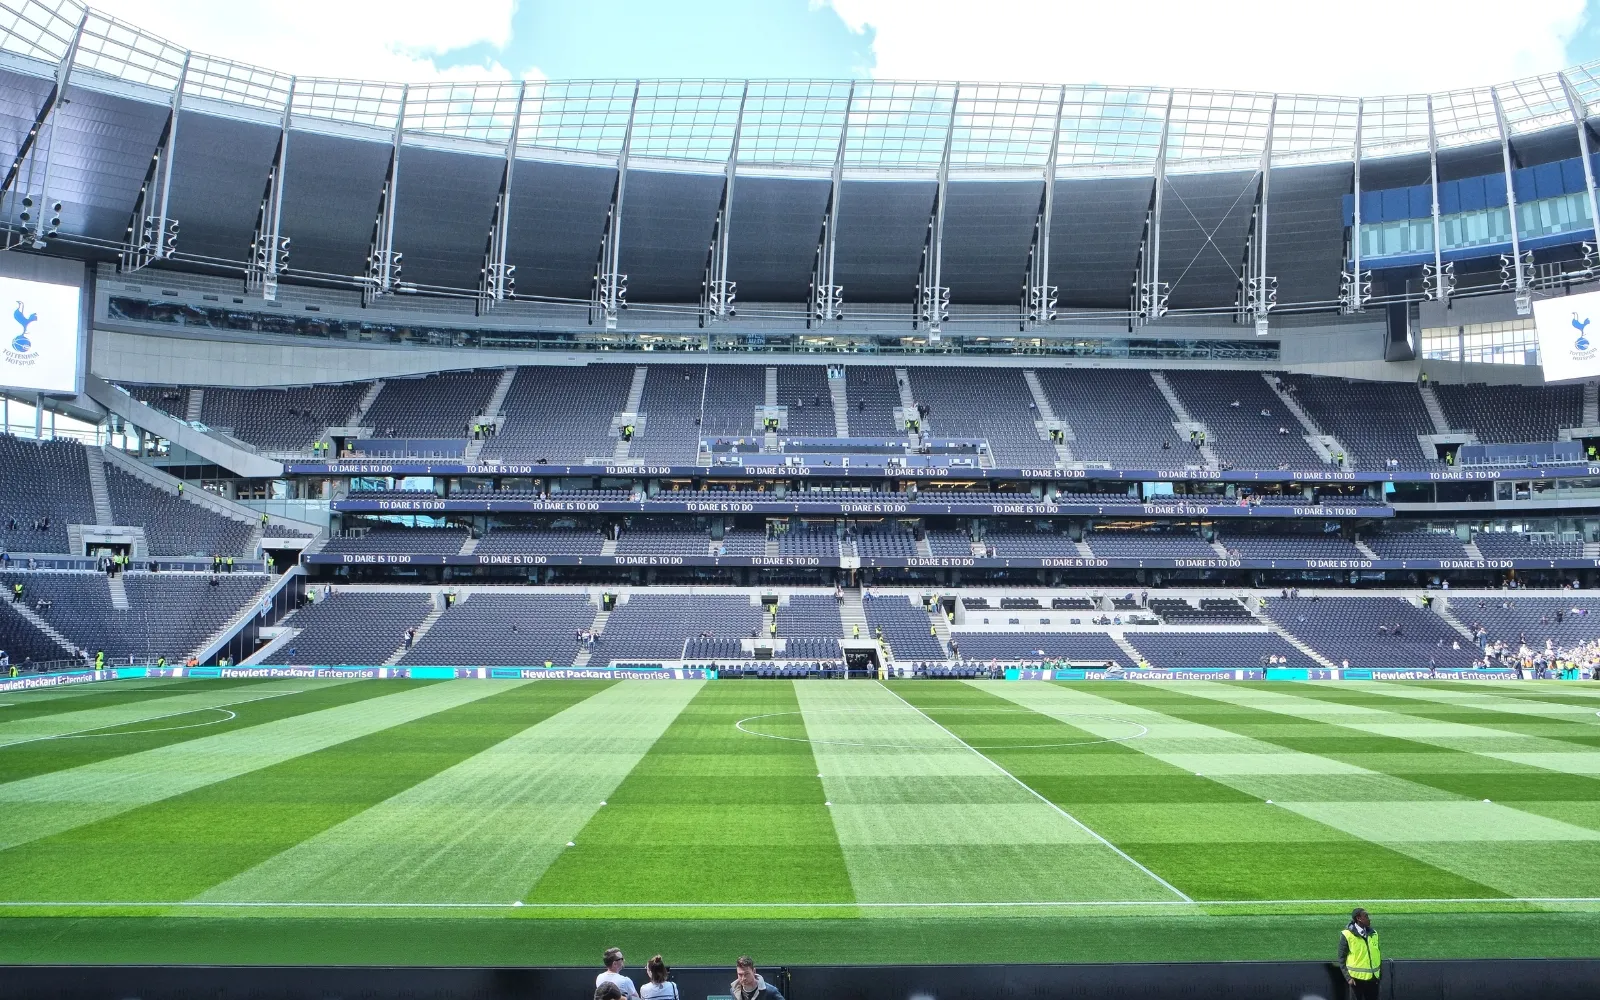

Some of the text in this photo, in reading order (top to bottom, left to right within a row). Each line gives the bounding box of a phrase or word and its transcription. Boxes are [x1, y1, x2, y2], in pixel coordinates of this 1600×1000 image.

[2, 348, 40, 358] TOTTENHAM
[467, 465, 531, 473] TO DARE IS TO DO
[1022, 469, 1085, 477] TO DARE IS TO DO
[1587, 467, 1599, 475] TO
[1442, 472, 1463, 480] DARE
[533, 502, 598, 510] TO DARE IS TO DO
[993, 505, 1058, 513] TO DARE IS TO DO
[1144, 506, 1208, 514] TO DARE IS TO DO
[752, 557, 819, 565] TO DARE IS TO DO
[1175, 559, 1240, 567] TO DARE IS TO DO
[1440, 560, 1513, 568] TO DARE IS TO DO
[221, 668, 374, 678] Hewlett Packard Enterprise
[521, 669, 670, 679] Hewlett Packard Enterprise
[1085, 671, 1230, 680] Hewt Packard Enterprise
[1372, 671, 1415, 680] Hewlett
[1463, 672, 1518, 680] Enterprise
[0, 675, 93, 691] ewlett Packard Enterprise
